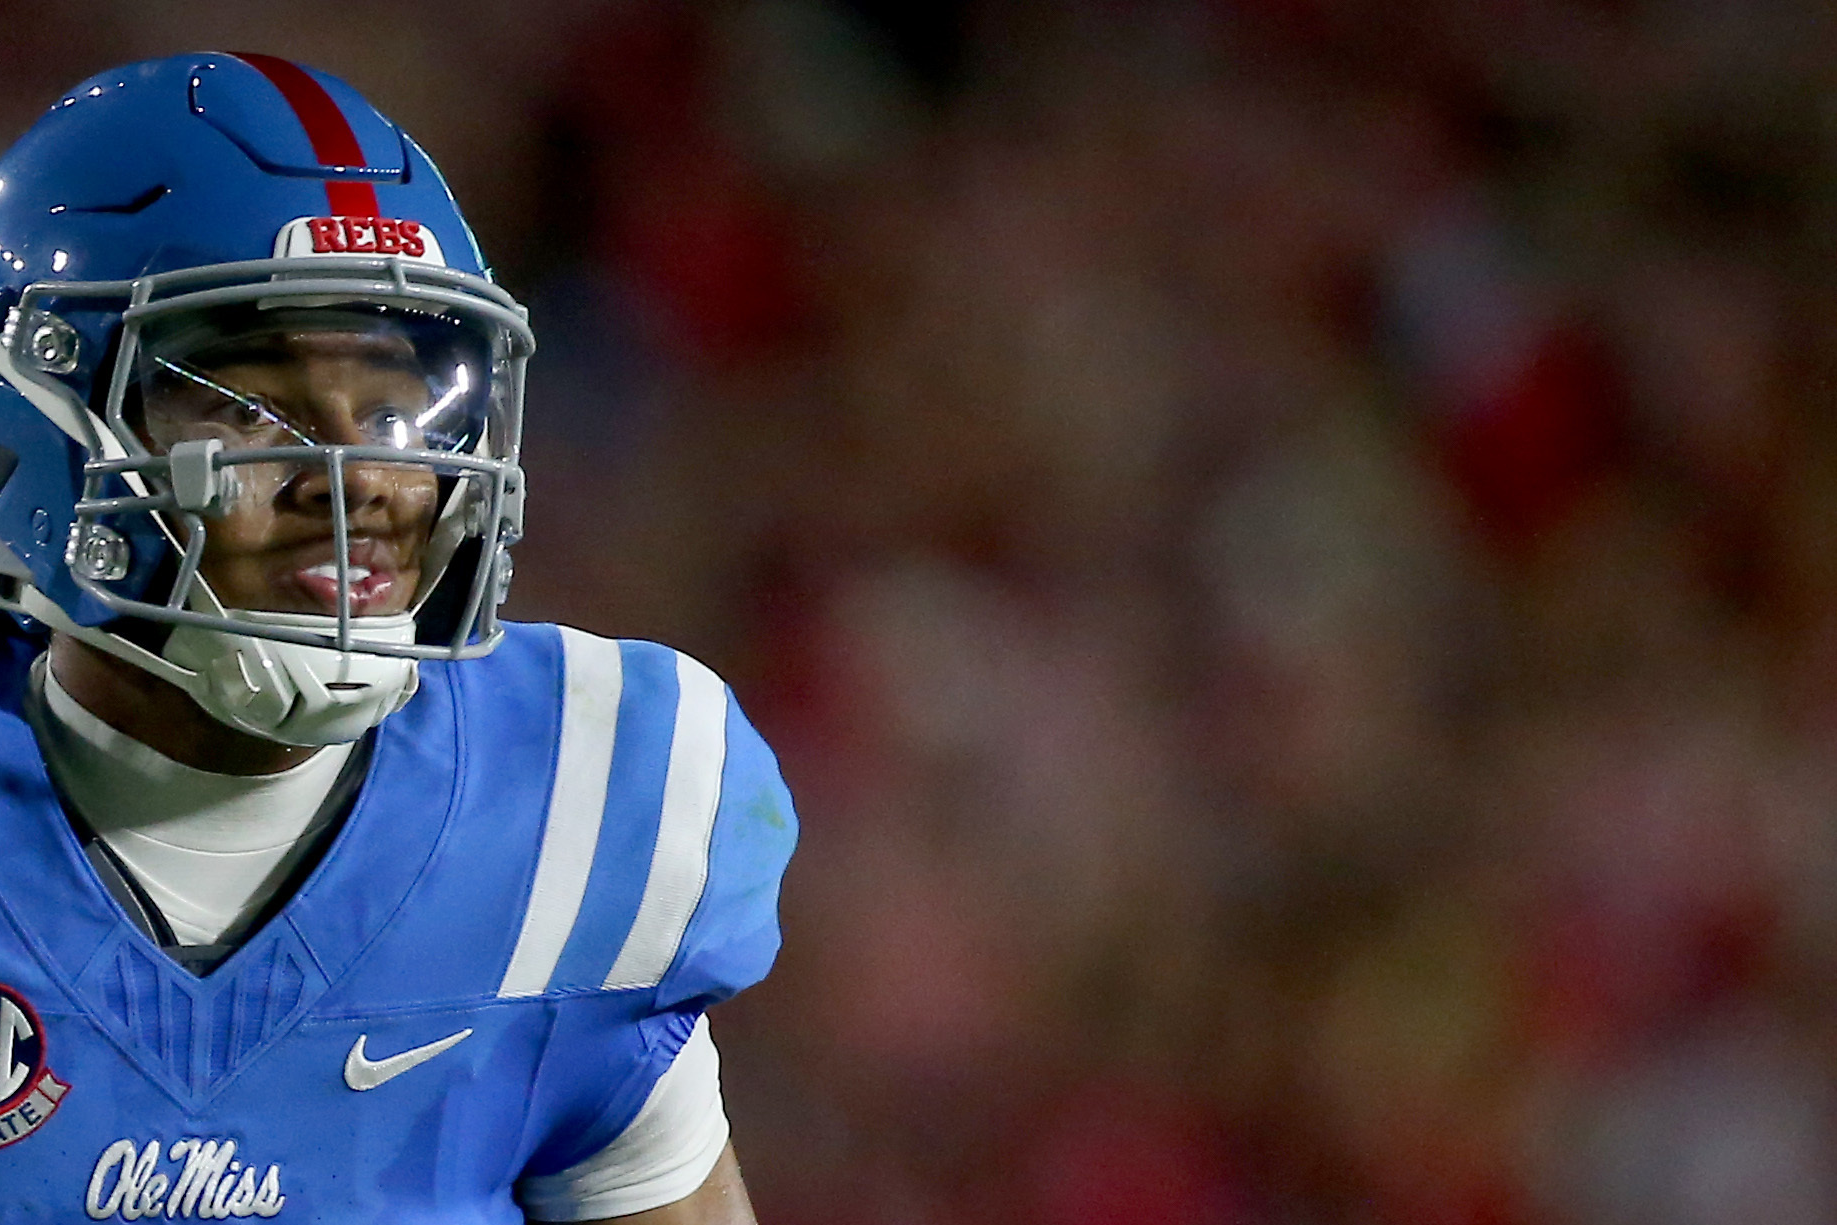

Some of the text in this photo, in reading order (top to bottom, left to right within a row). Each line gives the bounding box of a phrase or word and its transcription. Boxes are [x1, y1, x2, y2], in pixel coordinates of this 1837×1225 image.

[307, 217, 425, 257] REBS
[86, 1139, 286, 1220] Ole Miss
